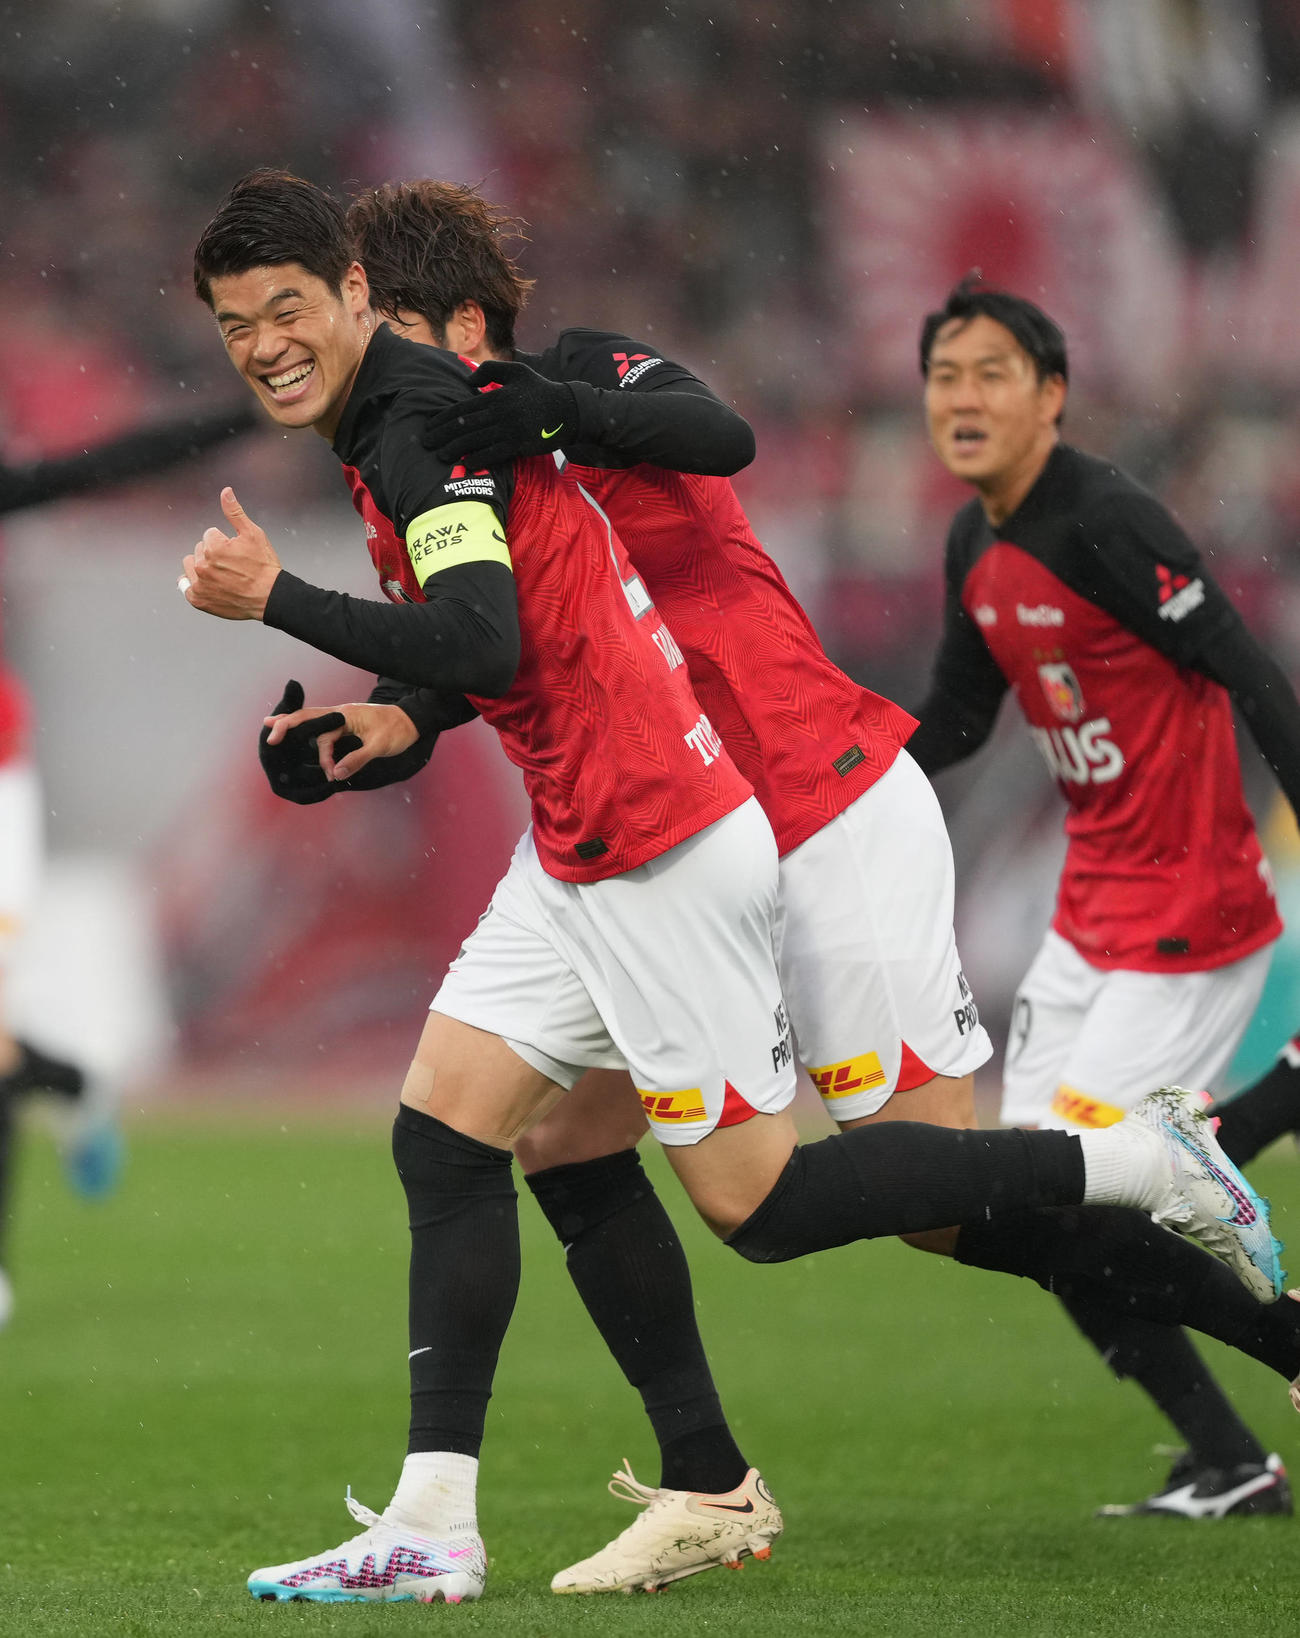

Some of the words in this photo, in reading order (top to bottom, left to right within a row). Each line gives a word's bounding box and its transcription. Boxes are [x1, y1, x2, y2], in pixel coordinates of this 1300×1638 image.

[443, 478, 496, 493] MITSUBISH
[454, 486, 494, 496] MOTORS
[414, 535, 463, 565] REDS
